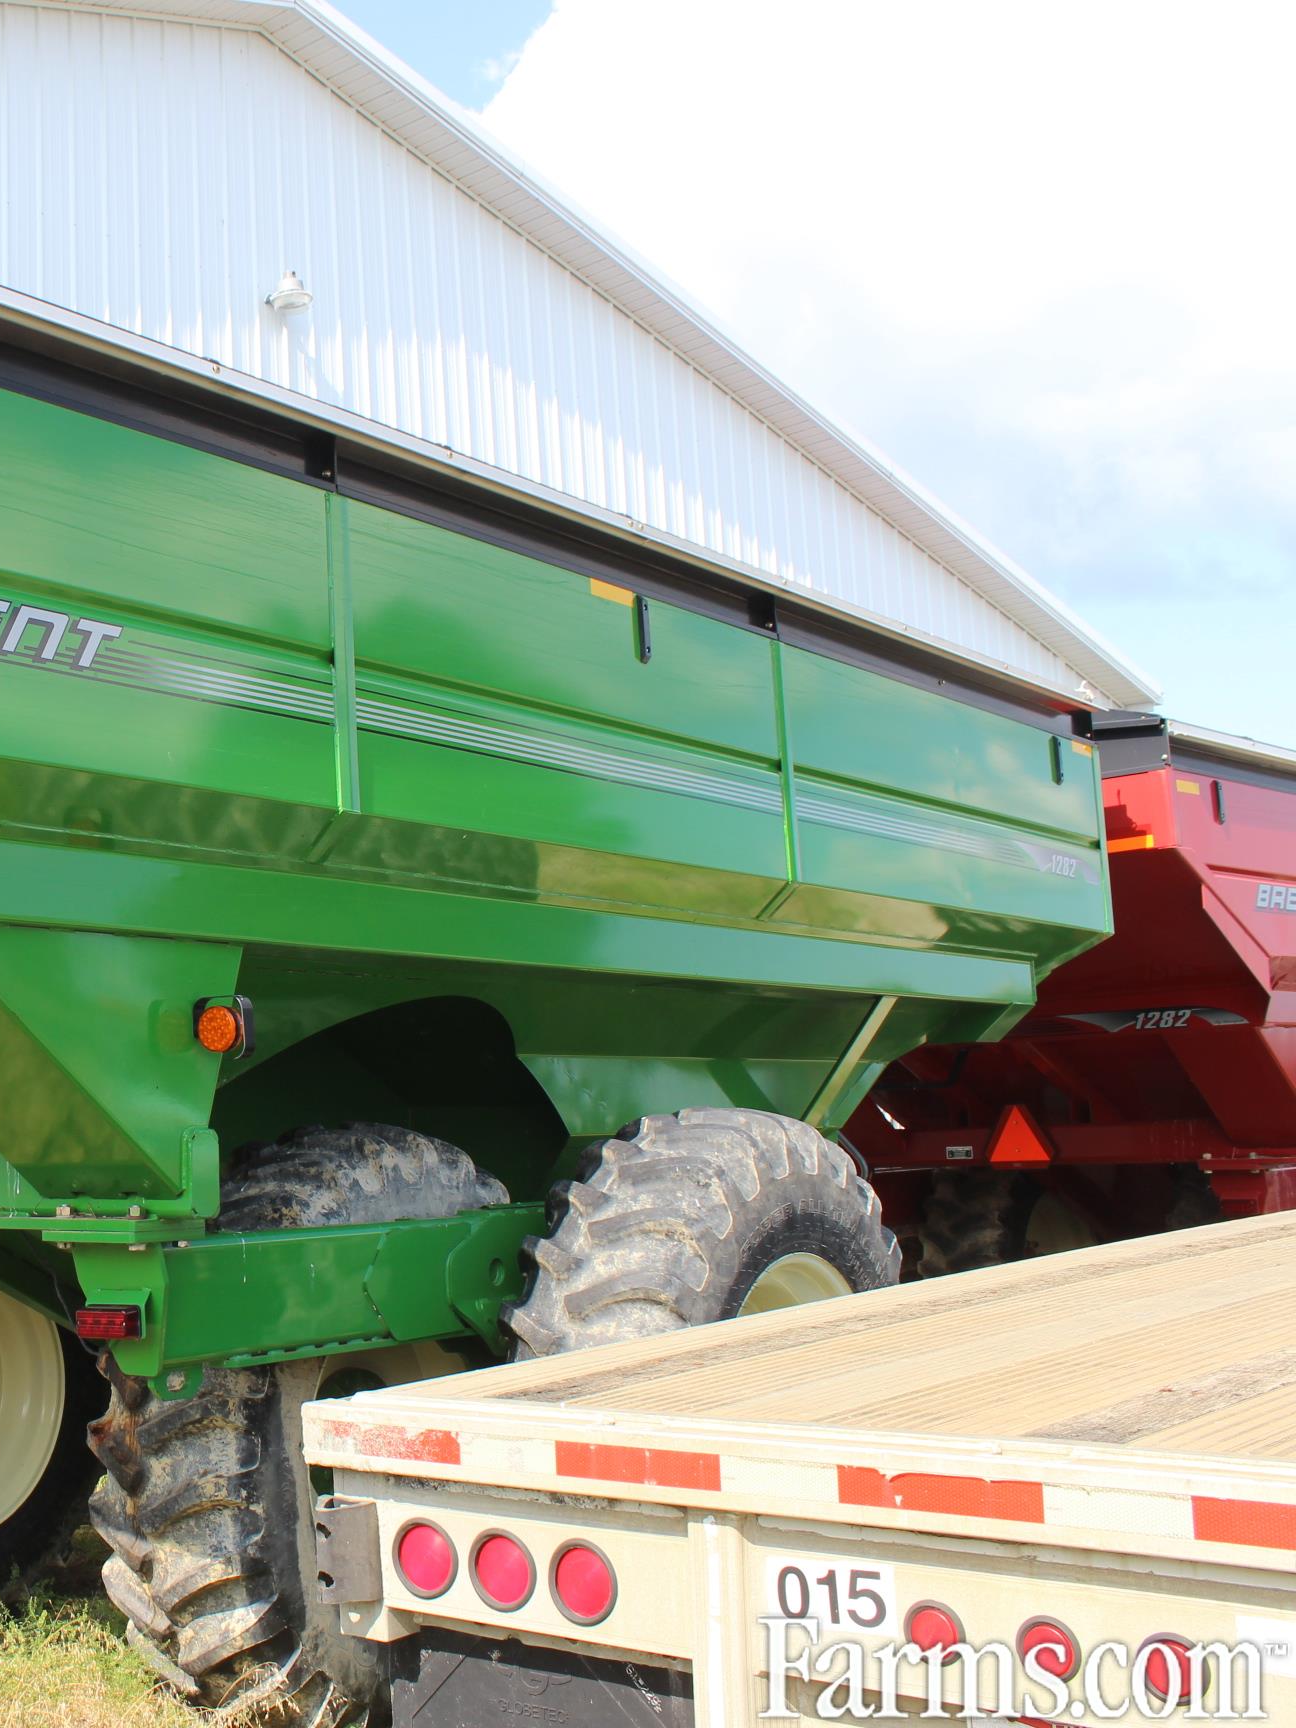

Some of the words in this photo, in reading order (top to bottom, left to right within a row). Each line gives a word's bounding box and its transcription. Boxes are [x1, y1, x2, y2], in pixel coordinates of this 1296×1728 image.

[1052, 855, 1076, 878] 1282
[1135, 1009, 1192, 1030] 1282
[777, 1566, 886, 1628] 015
